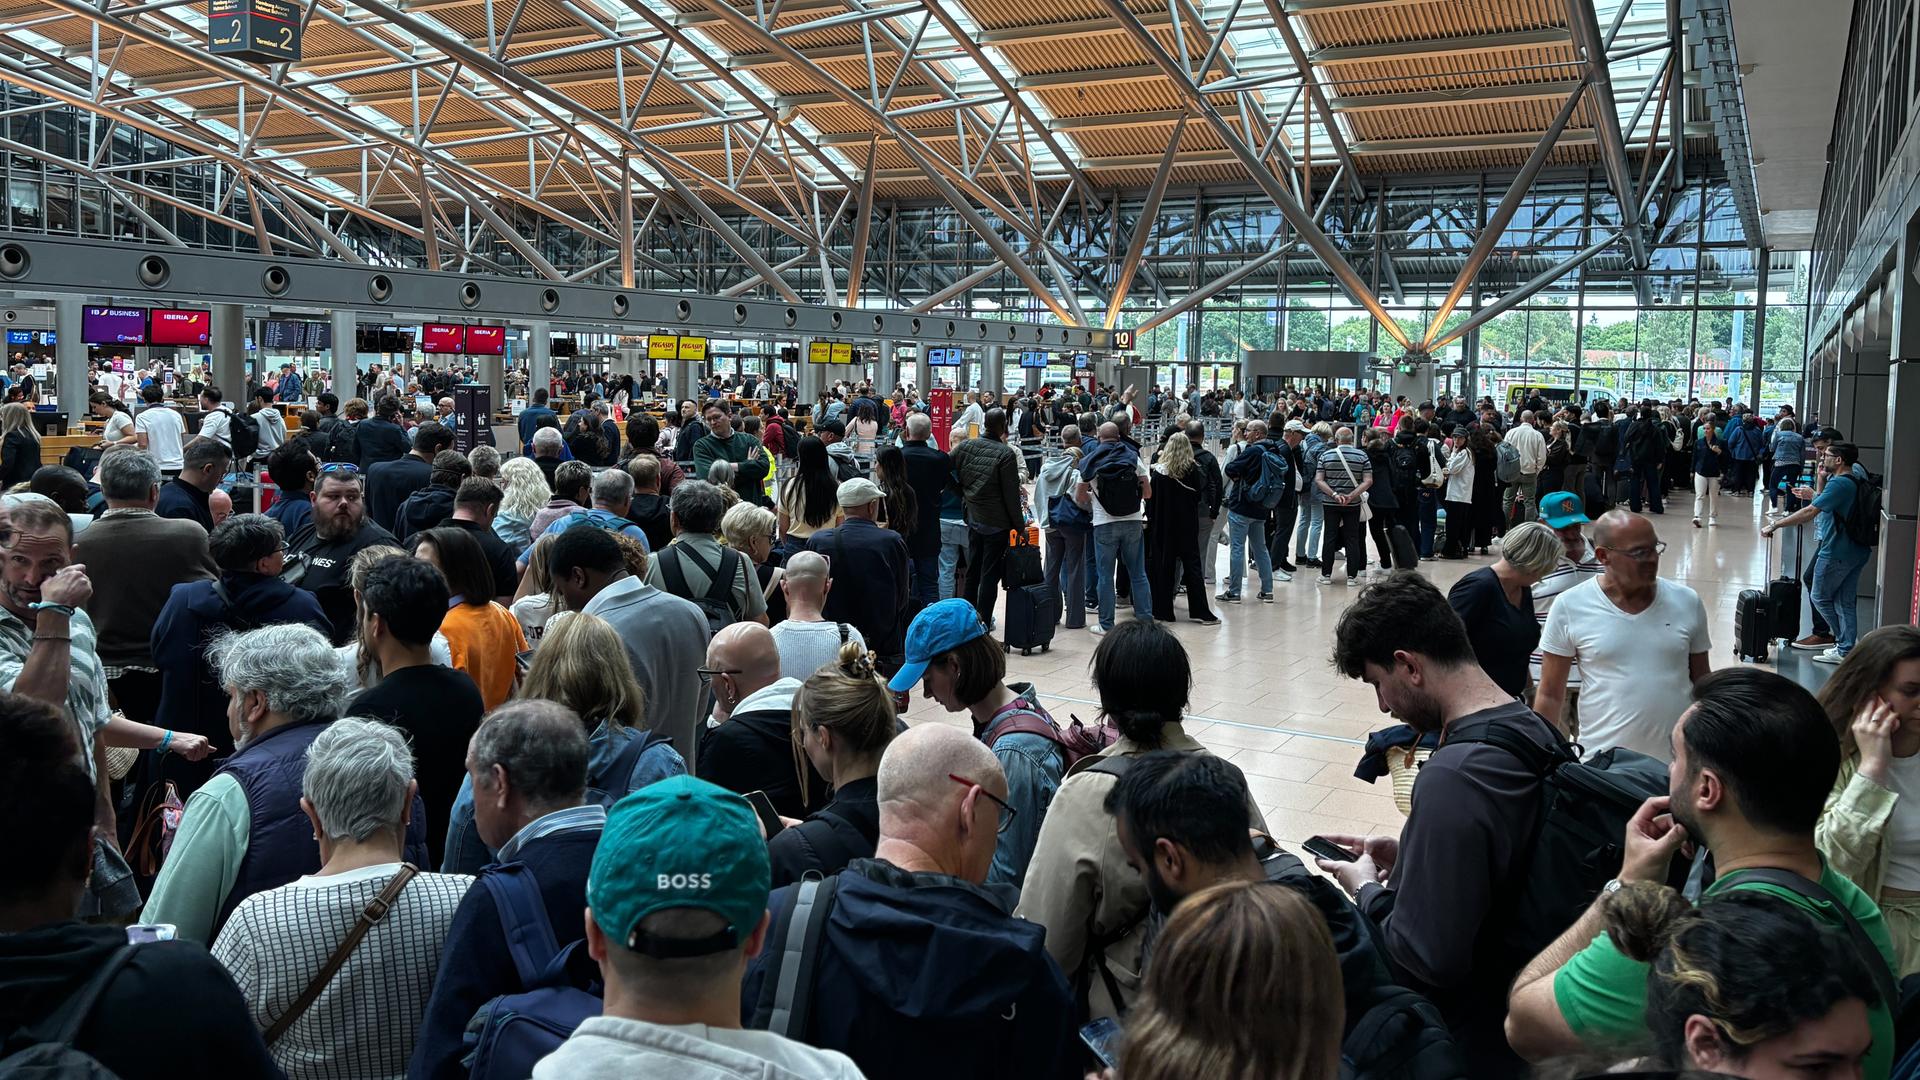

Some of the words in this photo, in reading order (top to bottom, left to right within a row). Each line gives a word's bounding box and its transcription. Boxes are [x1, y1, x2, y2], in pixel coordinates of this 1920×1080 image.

[231, 19, 241, 43] 2
[255, 37, 278, 48] Terminal
[280, 27, 293, 51] 2
[109, 309, 140, 317] BUSINESS
[651, 341, 675, 349] PEGASUS
[1114, 332, 1129, 345] 10
[681, 342, 704, 350] PEGASUS
[656, 872, 713, 890] BOSS
